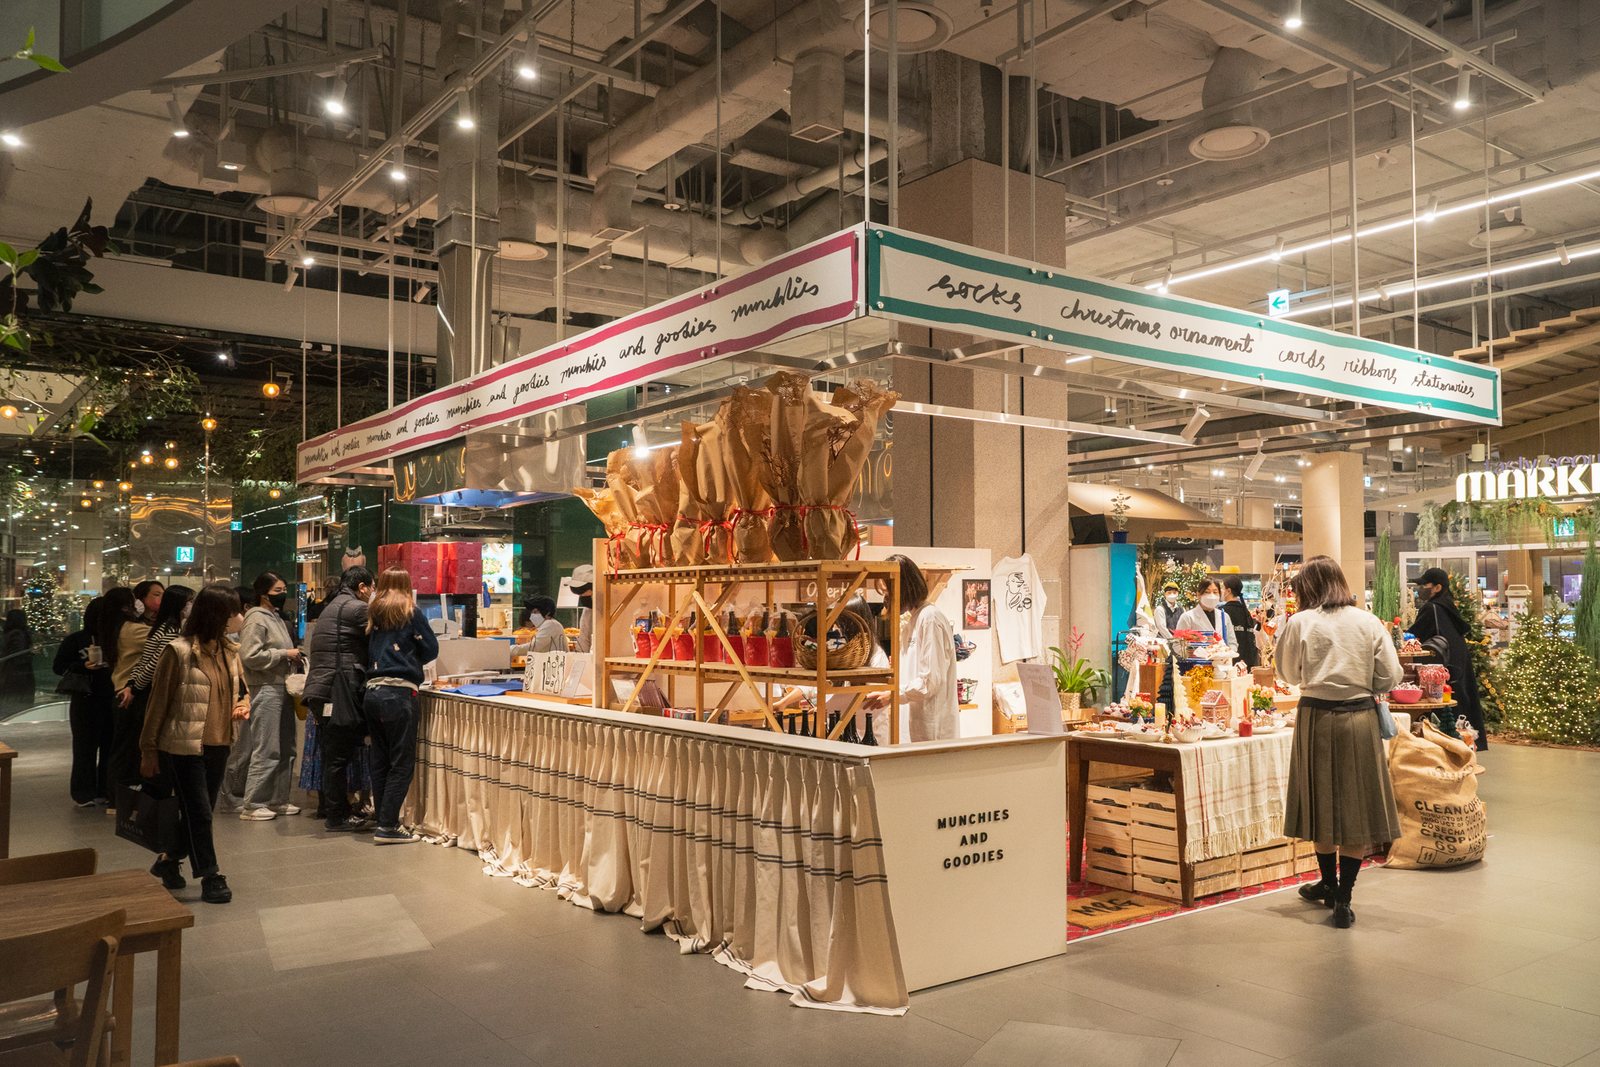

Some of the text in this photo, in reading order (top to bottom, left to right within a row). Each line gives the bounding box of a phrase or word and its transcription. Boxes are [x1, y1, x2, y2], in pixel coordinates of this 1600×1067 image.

[927, 275, 1022, 313] socks
[1169, 325, 1253, 354] ornament
[1278, 349, 1326, 371] cards
[1343, 358, 1397, 384] ribbons
[1411, 370, 1474, 398] stationaries
[396, 420, 408, 436] and
[414, 412, 440, 433] goodies
[446, 397, 482, 420] munchies
[487, 384, 507, 407] and
[513, 373, 550, 404] goodies
[560, 353, 607, 383] munchies
[619, 336, 646, 359] and
[655, 317, 717, 355] goodies
[731, 276, 819, 322] munchies
[1414, 800, 1462, 815] CLEAN
[937, 809, 1009, 829] MUNCHIES
[1420, 828, 1466, 844] CROP
[1421, 822, 1465, 835] COSECHA
[960, 832, 988, 846] AND
[1435, 840, 1457, 854] 69
[943, 849, 1004, 869] GOODIES
